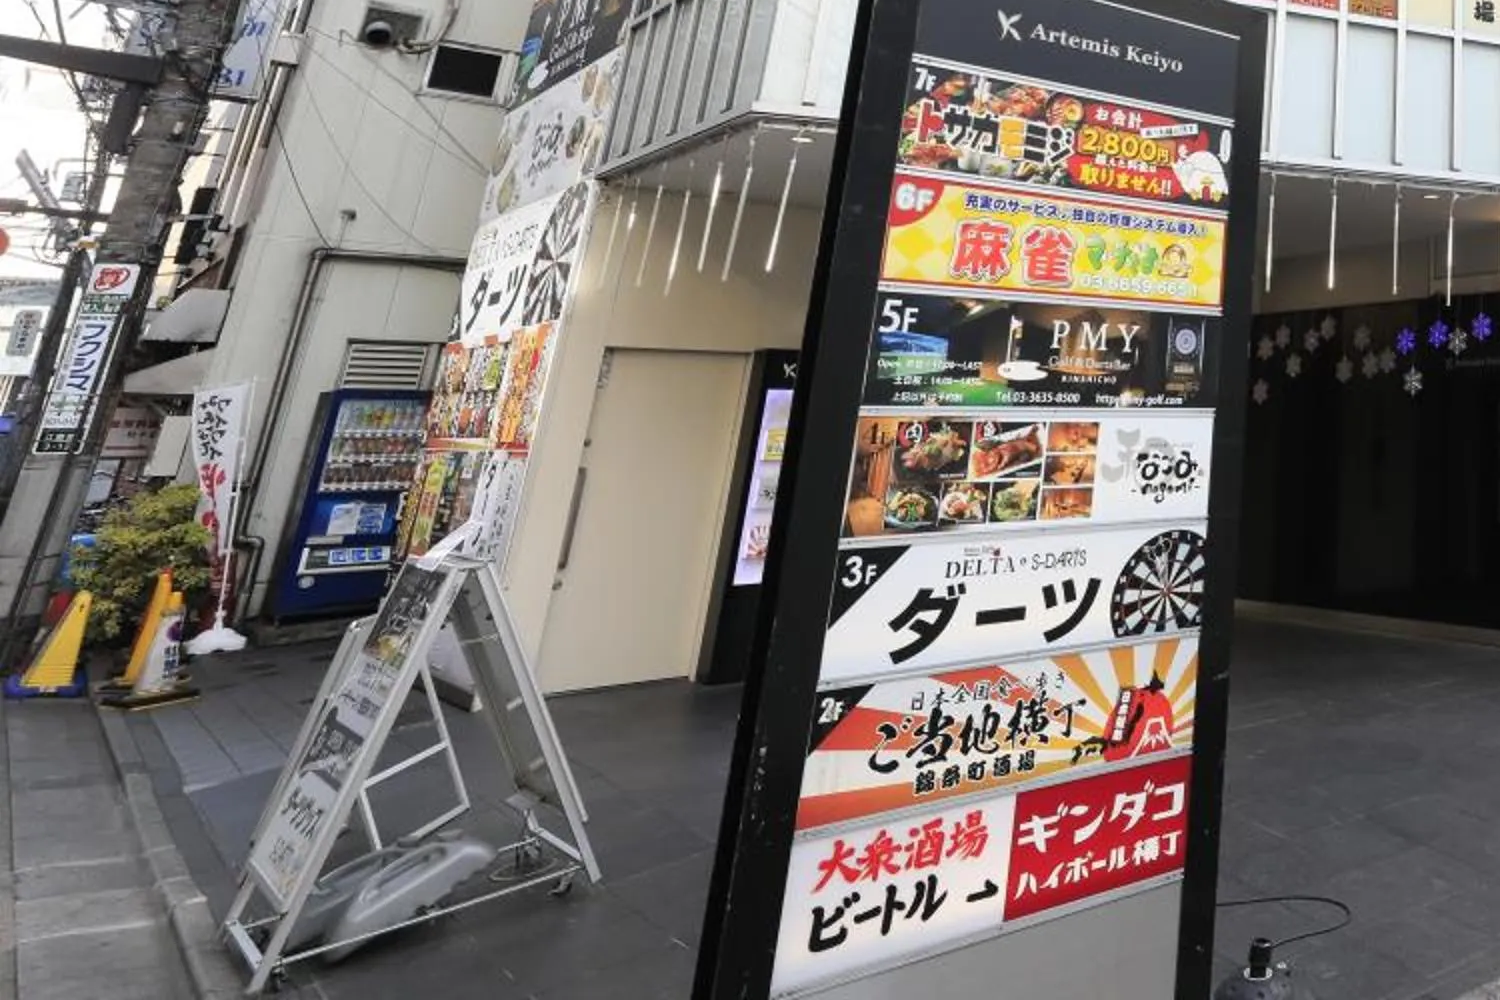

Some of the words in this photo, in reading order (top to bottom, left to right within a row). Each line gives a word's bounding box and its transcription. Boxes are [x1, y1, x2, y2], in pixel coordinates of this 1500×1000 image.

[1029, 21, 1121, 58] Artemis
[1124, 44, 1185, 74] Keiyo
[914, 66, 936, 93] 7F
[894, 183, 934, 212] 6F
[948, 218, 1075, 288] 麻雀
[466, 262, 528, 334] ダーツ
[877, 298, 919, 334] 5F
[1050, 319, 1142, 354] PMY
[840, 554, 878, 589] 3F
[944, 556, 1017, 580] DELTA
[888, 577, 1103, 665] ダーツ
[818, 697, 845, 725] 2F
[866, 696, 1088, 774] ご当地横丁
[912, 749, 1037, 796] 錦糸町酒場
[1017, 780, 1186, 855] ギンダコ
[810, 809, 990, 894] 大衆酒場
[1013, 829, 1184, 901] ハイボール横丁
[807, 874, 948, 954] ビートル
